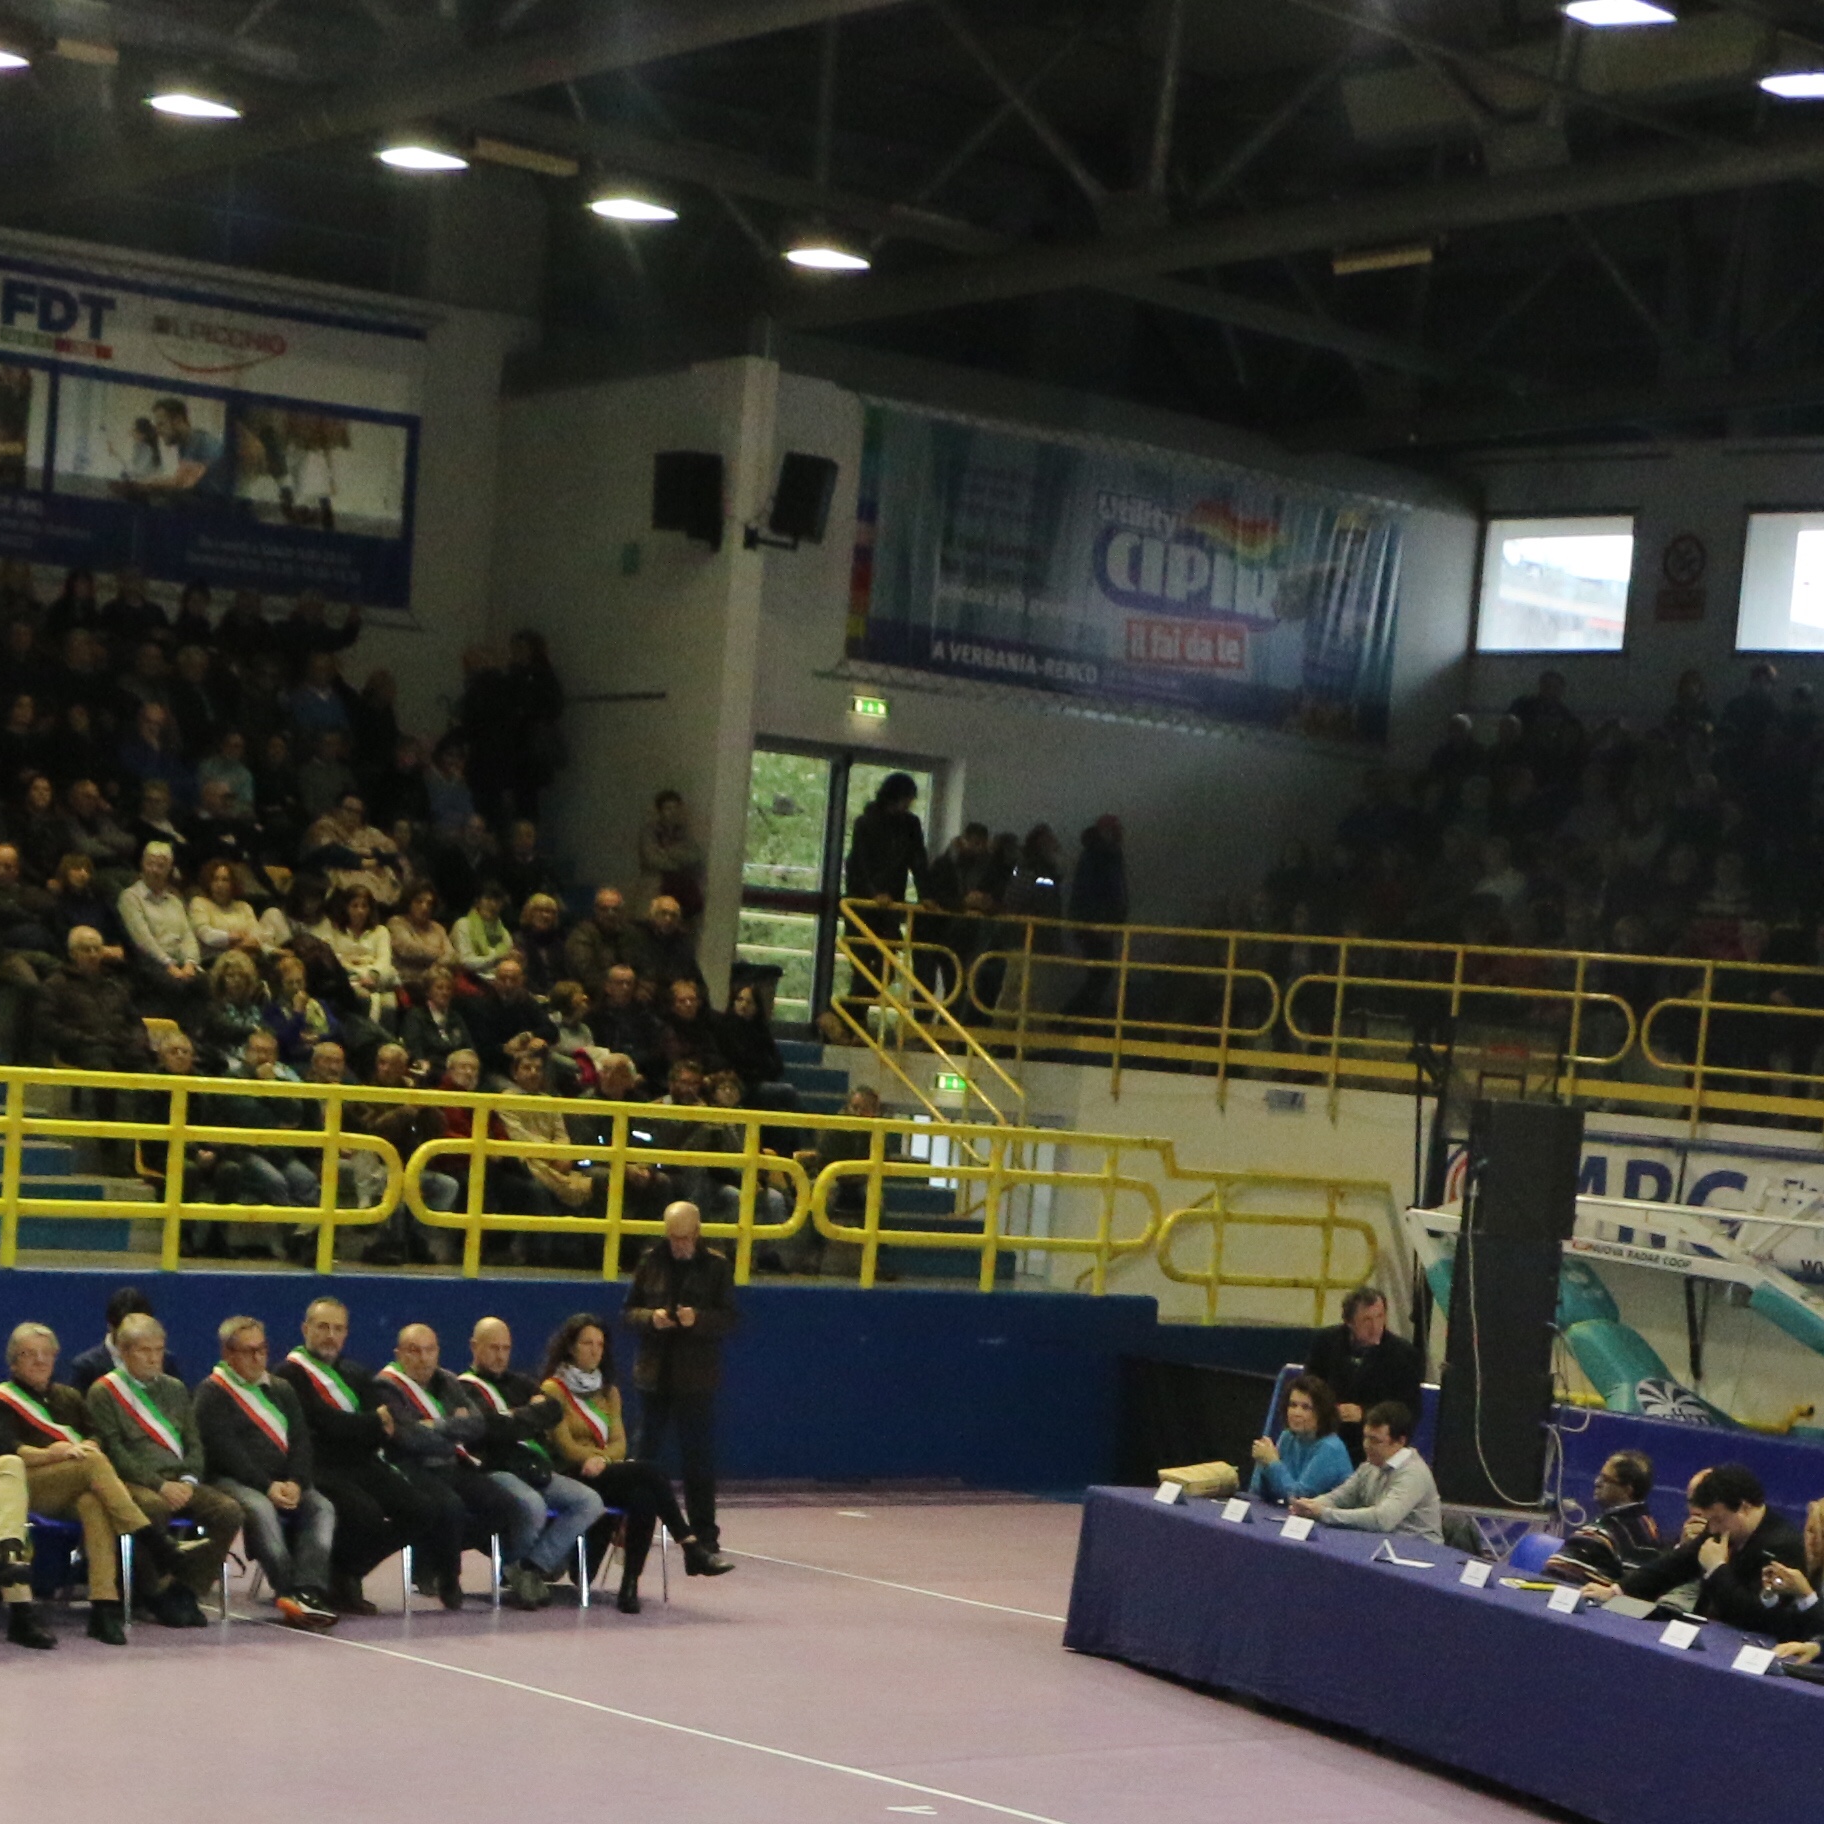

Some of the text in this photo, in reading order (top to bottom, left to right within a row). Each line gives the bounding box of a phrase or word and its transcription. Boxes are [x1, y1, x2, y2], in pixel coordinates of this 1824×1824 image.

[0, 276, 117, 342] FDT
[931, 639, 945, 660] A
[1150, 621, 1180, 661] fai
[1183, 627, 1214, 665] da
[1216, 630, 1242, 665] te
